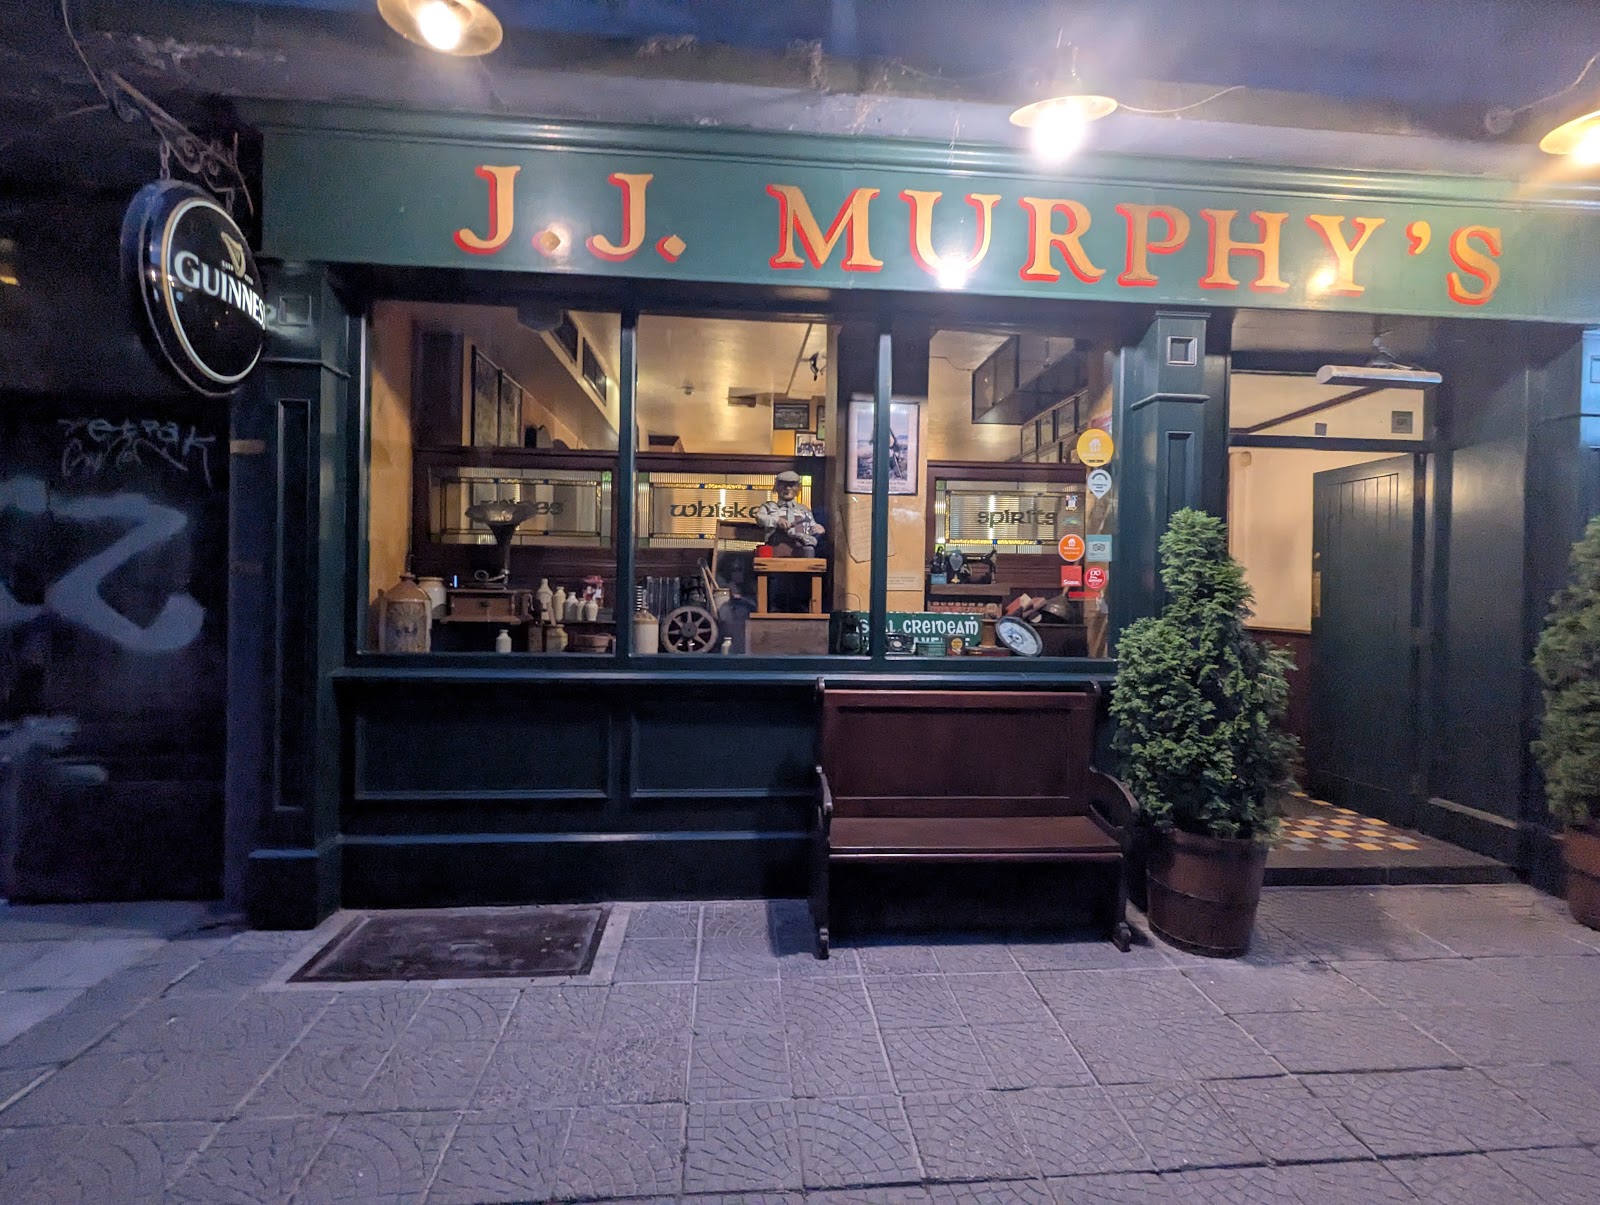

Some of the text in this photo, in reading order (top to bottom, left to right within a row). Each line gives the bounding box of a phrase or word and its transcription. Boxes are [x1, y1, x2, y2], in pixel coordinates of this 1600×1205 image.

[765, 183, 1502, 307] MURPHY'S
[174, 250, 266, 331] GUINNES
[669, 500, 760, 518] whiske
[977, 509, 1057, 528] spirits
